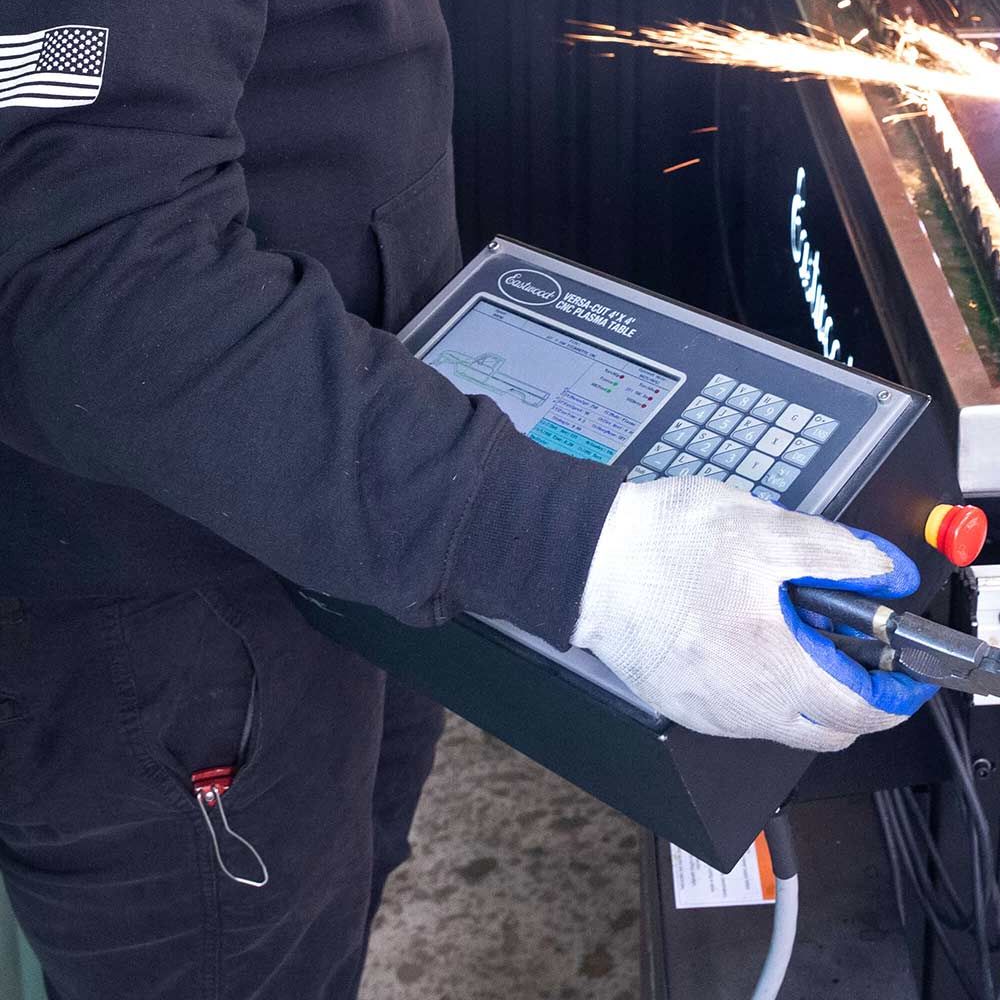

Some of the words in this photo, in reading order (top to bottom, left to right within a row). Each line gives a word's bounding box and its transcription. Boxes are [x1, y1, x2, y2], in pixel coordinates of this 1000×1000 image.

[504, 272, 556, 300] Eastwood
[555, 300, 576, 313] CNC
[572, 307, 609, 327] PLASMA
[607, 320, 637, 338] TABLE
[563, 292, 611, 316] VERSA-CUT
[616, 313, 627, 323] X
